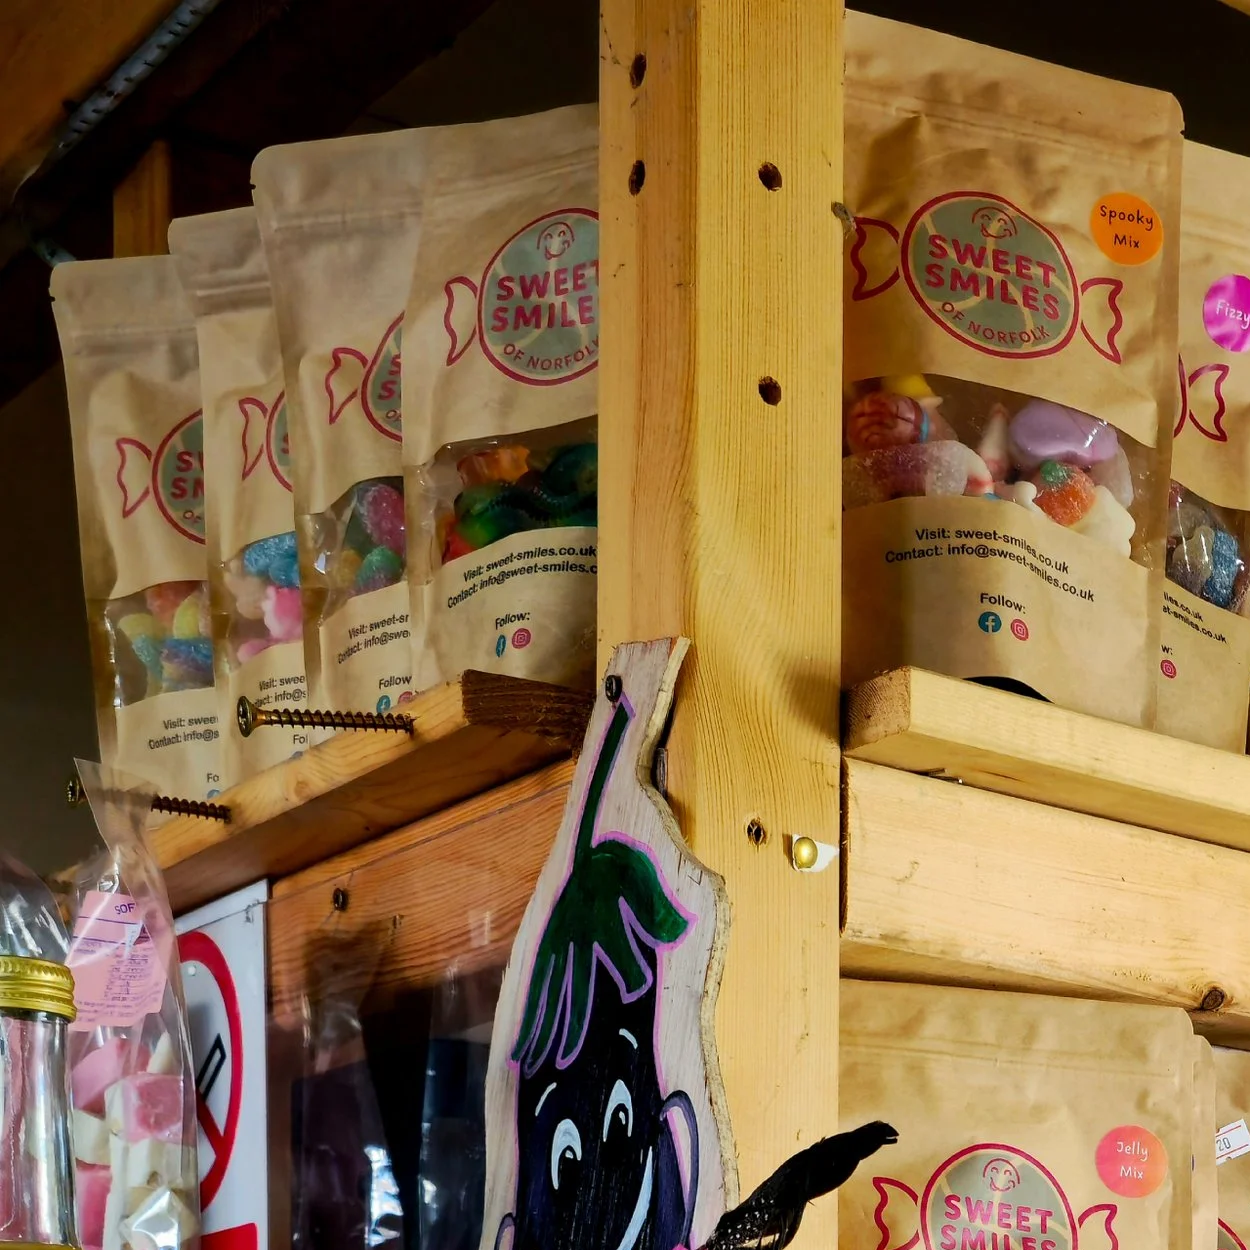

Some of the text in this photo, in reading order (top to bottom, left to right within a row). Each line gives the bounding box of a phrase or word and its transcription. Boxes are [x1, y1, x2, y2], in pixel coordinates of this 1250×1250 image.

[1100, 204, 1154, 231] Spooky
[1113, 233, 1140, 249] Mix
[928, 233, 1057, 289] SWEET
[925, 263, 1061, 321] SMILES
[491, 295, 598, 332] SMILE
[941, 301, 1050, 345] OF NORFOLK
[1215, 299, 1250, 330] Fizzy
[503, 343, 524, 361] OF
[463, 545, 597, 583] Visit: sweet-smiles.co.uk
[915, 528, 1069, 574] Visit: sweet-smiles.co.uk
[885, 543, 1094, 602] Contact: info@sweet-smiles.co.uk
[447, 581, 479, 609] Contact:
[979, 592, 1027, 614] Follow:
[494, 611, 530, 630] Follow:
[1116, 1141, 1149, 1162] Jelly
[1120, 1165, 1144, 1180] Mix
[944, 1194, 1053, 1235] SWEET
